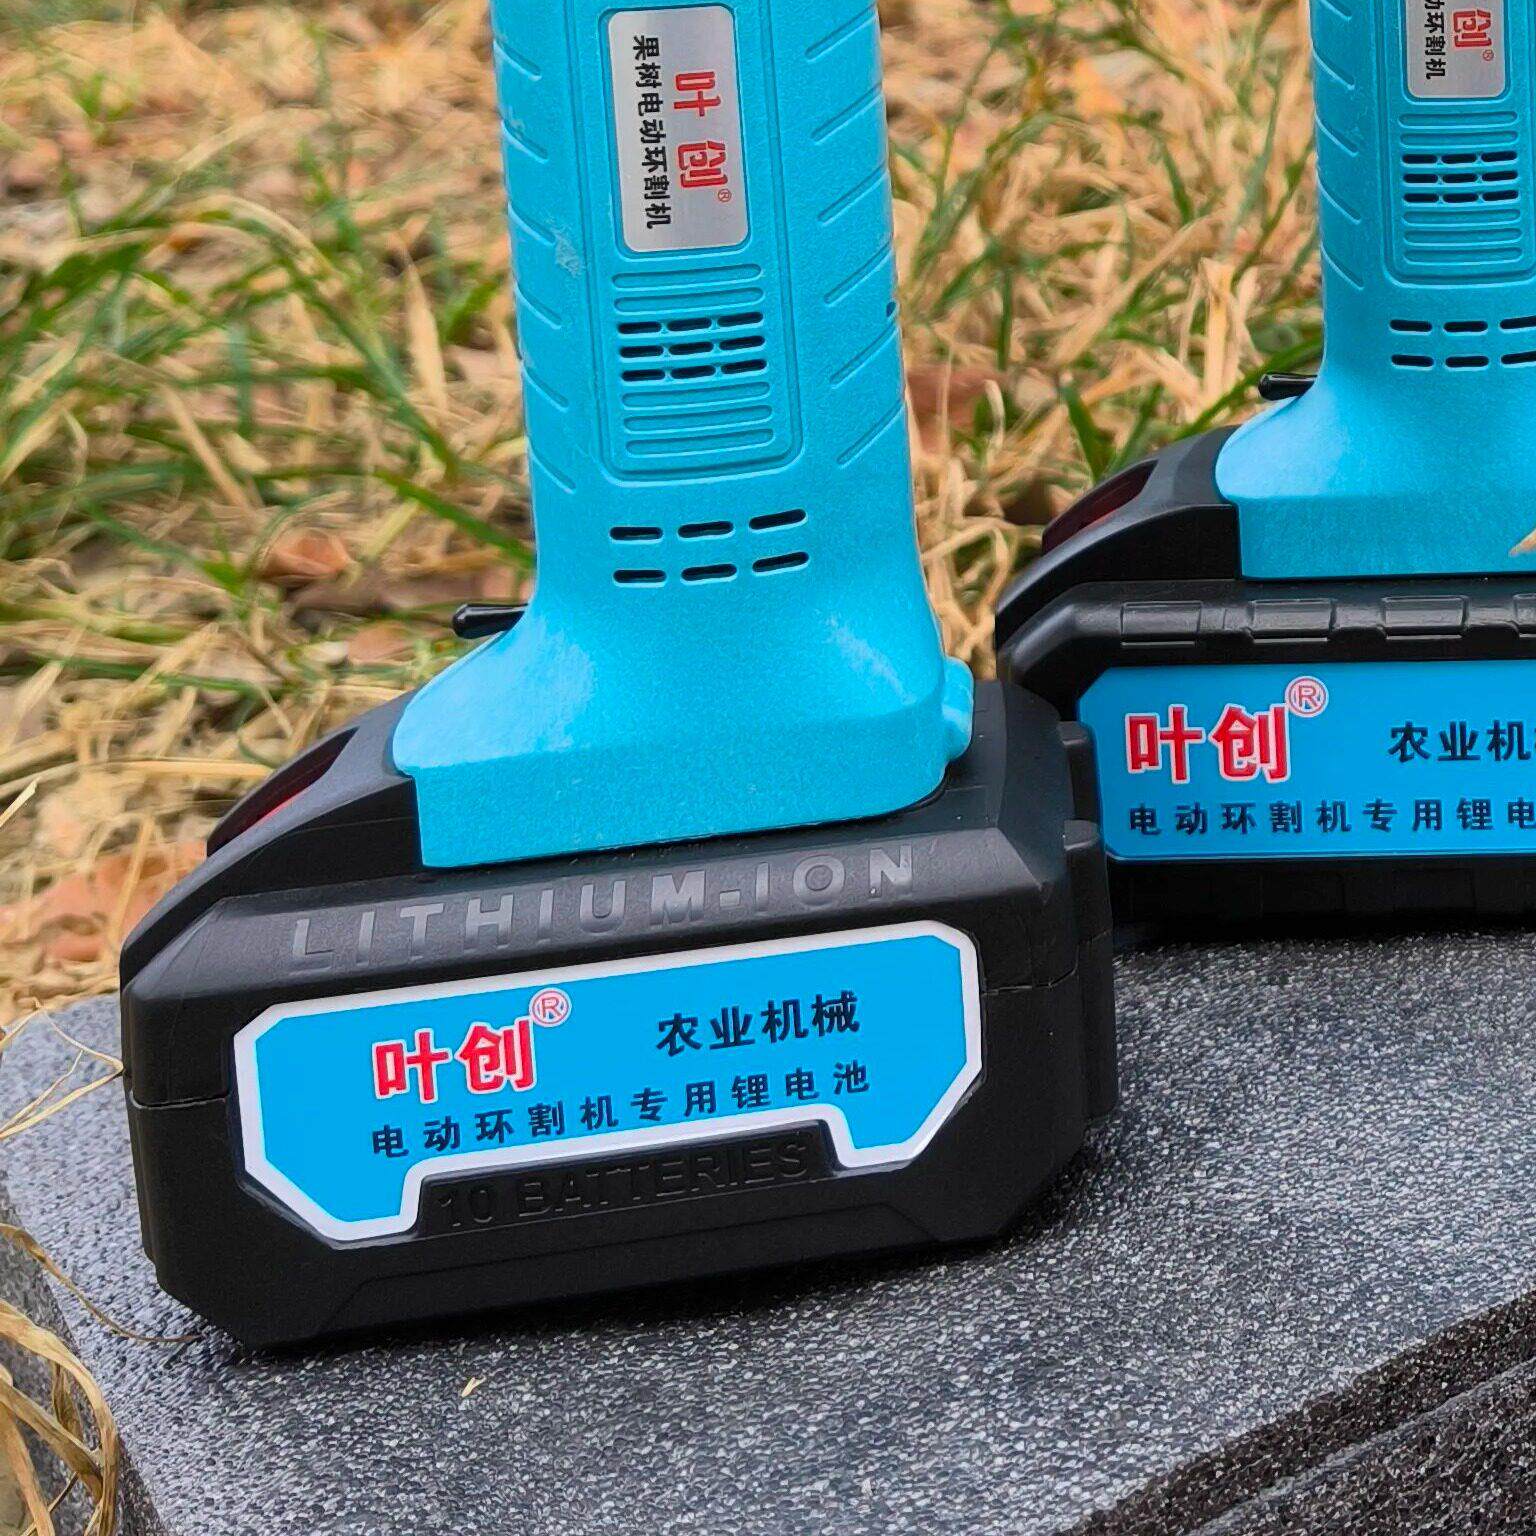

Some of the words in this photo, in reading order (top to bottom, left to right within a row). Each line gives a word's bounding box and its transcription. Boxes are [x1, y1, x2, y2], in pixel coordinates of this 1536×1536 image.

[633, 35, 673, 230] 果树电动环割机
[293, 844, 914, 969] LITHIUM-ION
[655, 989, 861, 1058] 农业机械
[372, 1060, 870, 1159] 电动环割机专用锂电池
[437, 1183, 497, 1229] 10
[517, 1142, 809, 1219] BATTERIES
